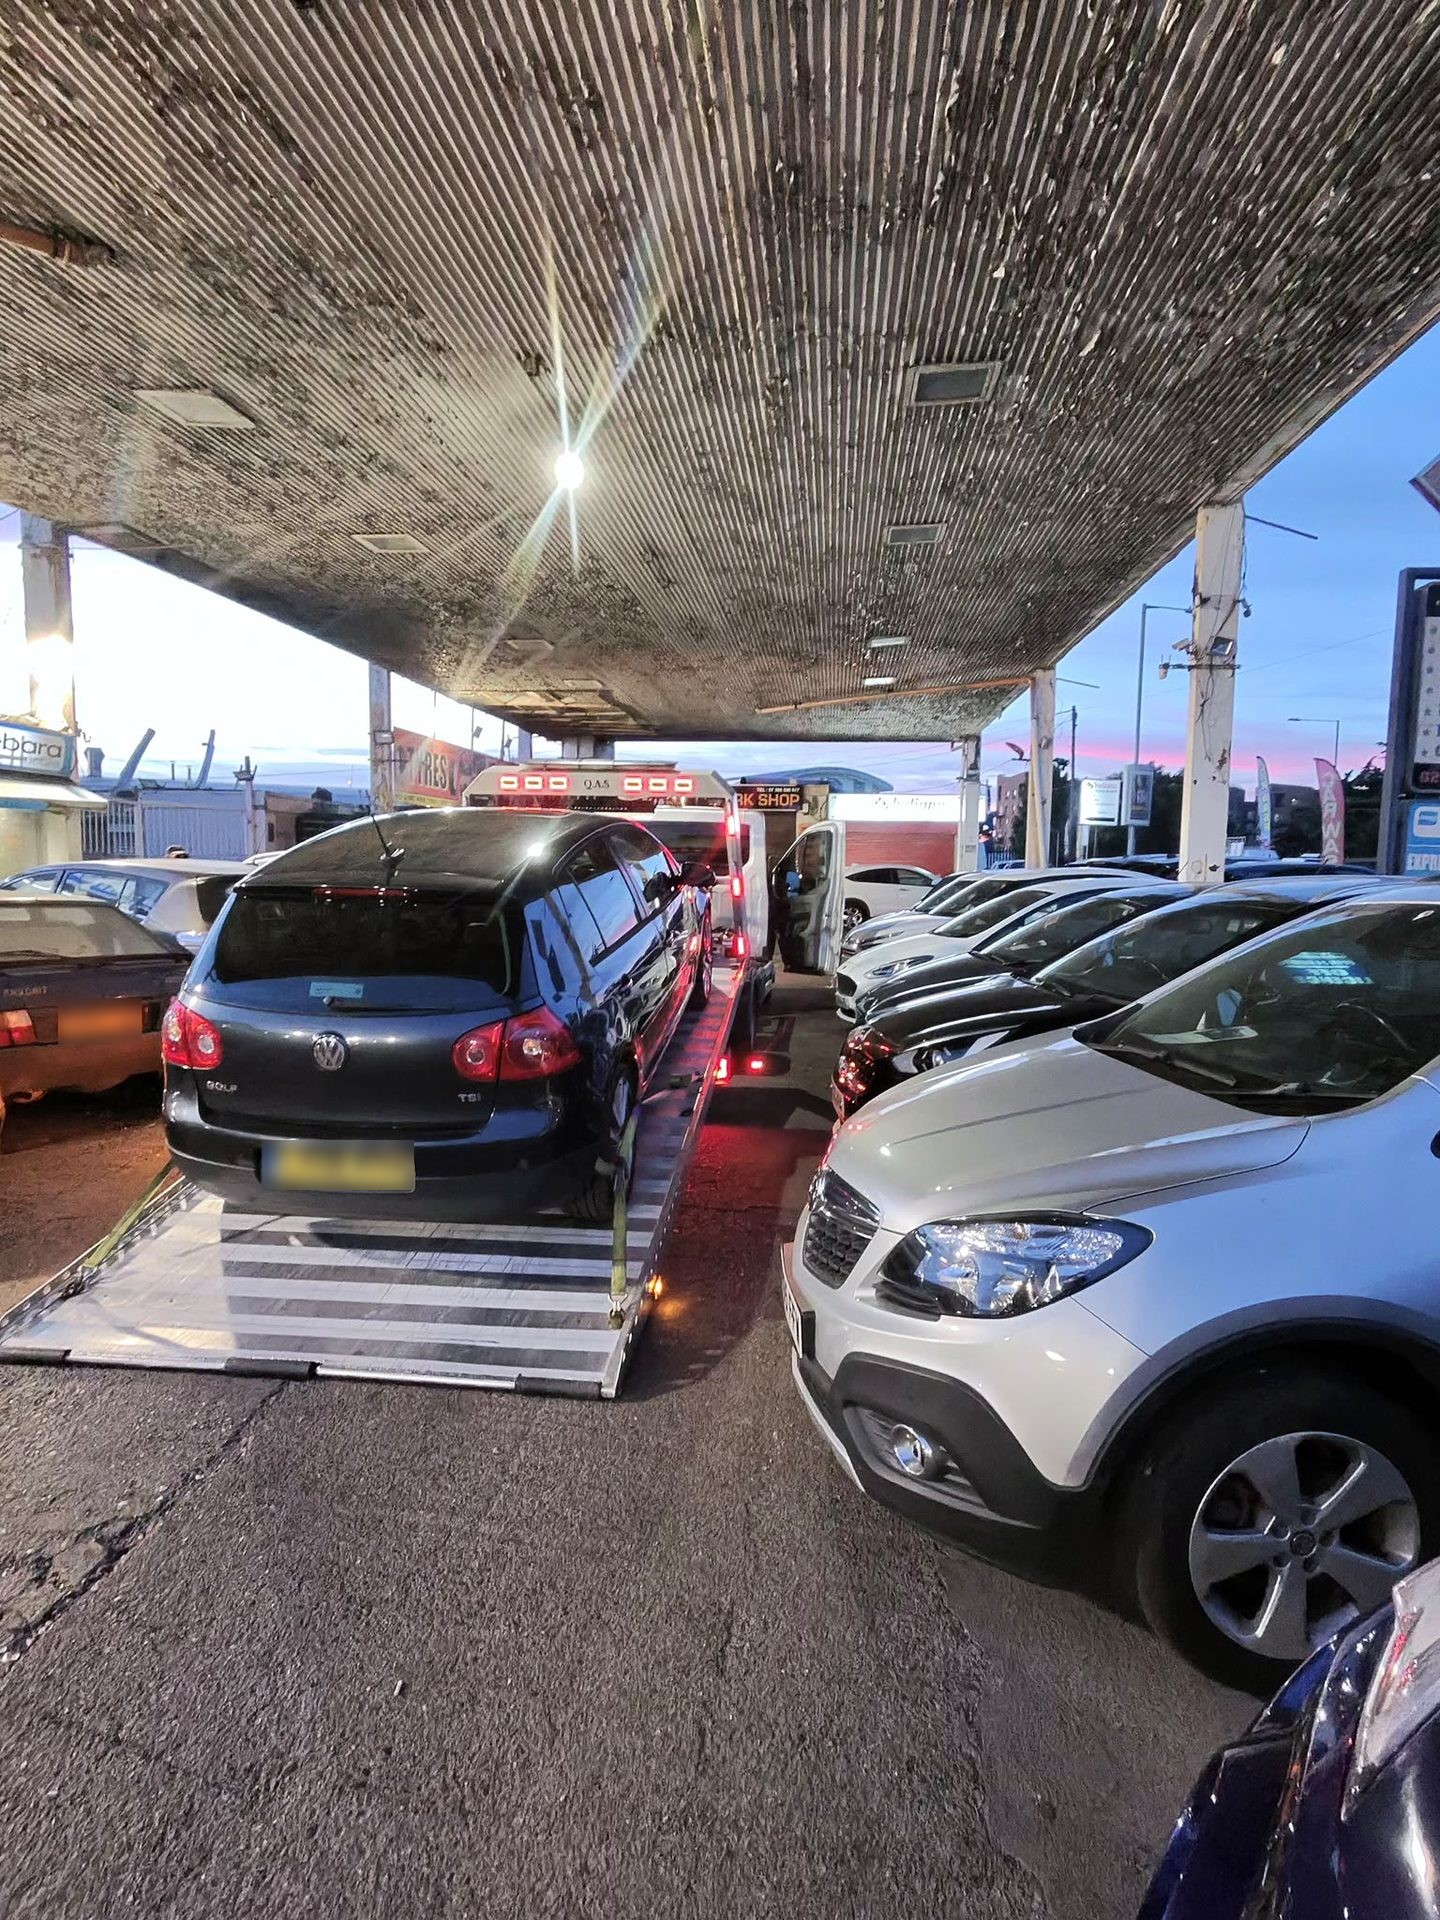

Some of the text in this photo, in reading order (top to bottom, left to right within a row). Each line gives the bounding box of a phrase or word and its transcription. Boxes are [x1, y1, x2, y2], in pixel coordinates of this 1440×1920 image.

[0, 732, 62, 758] bara
[757, 793, 800, 807] SHOP
[457, 1092, 482, 1103] TSI
